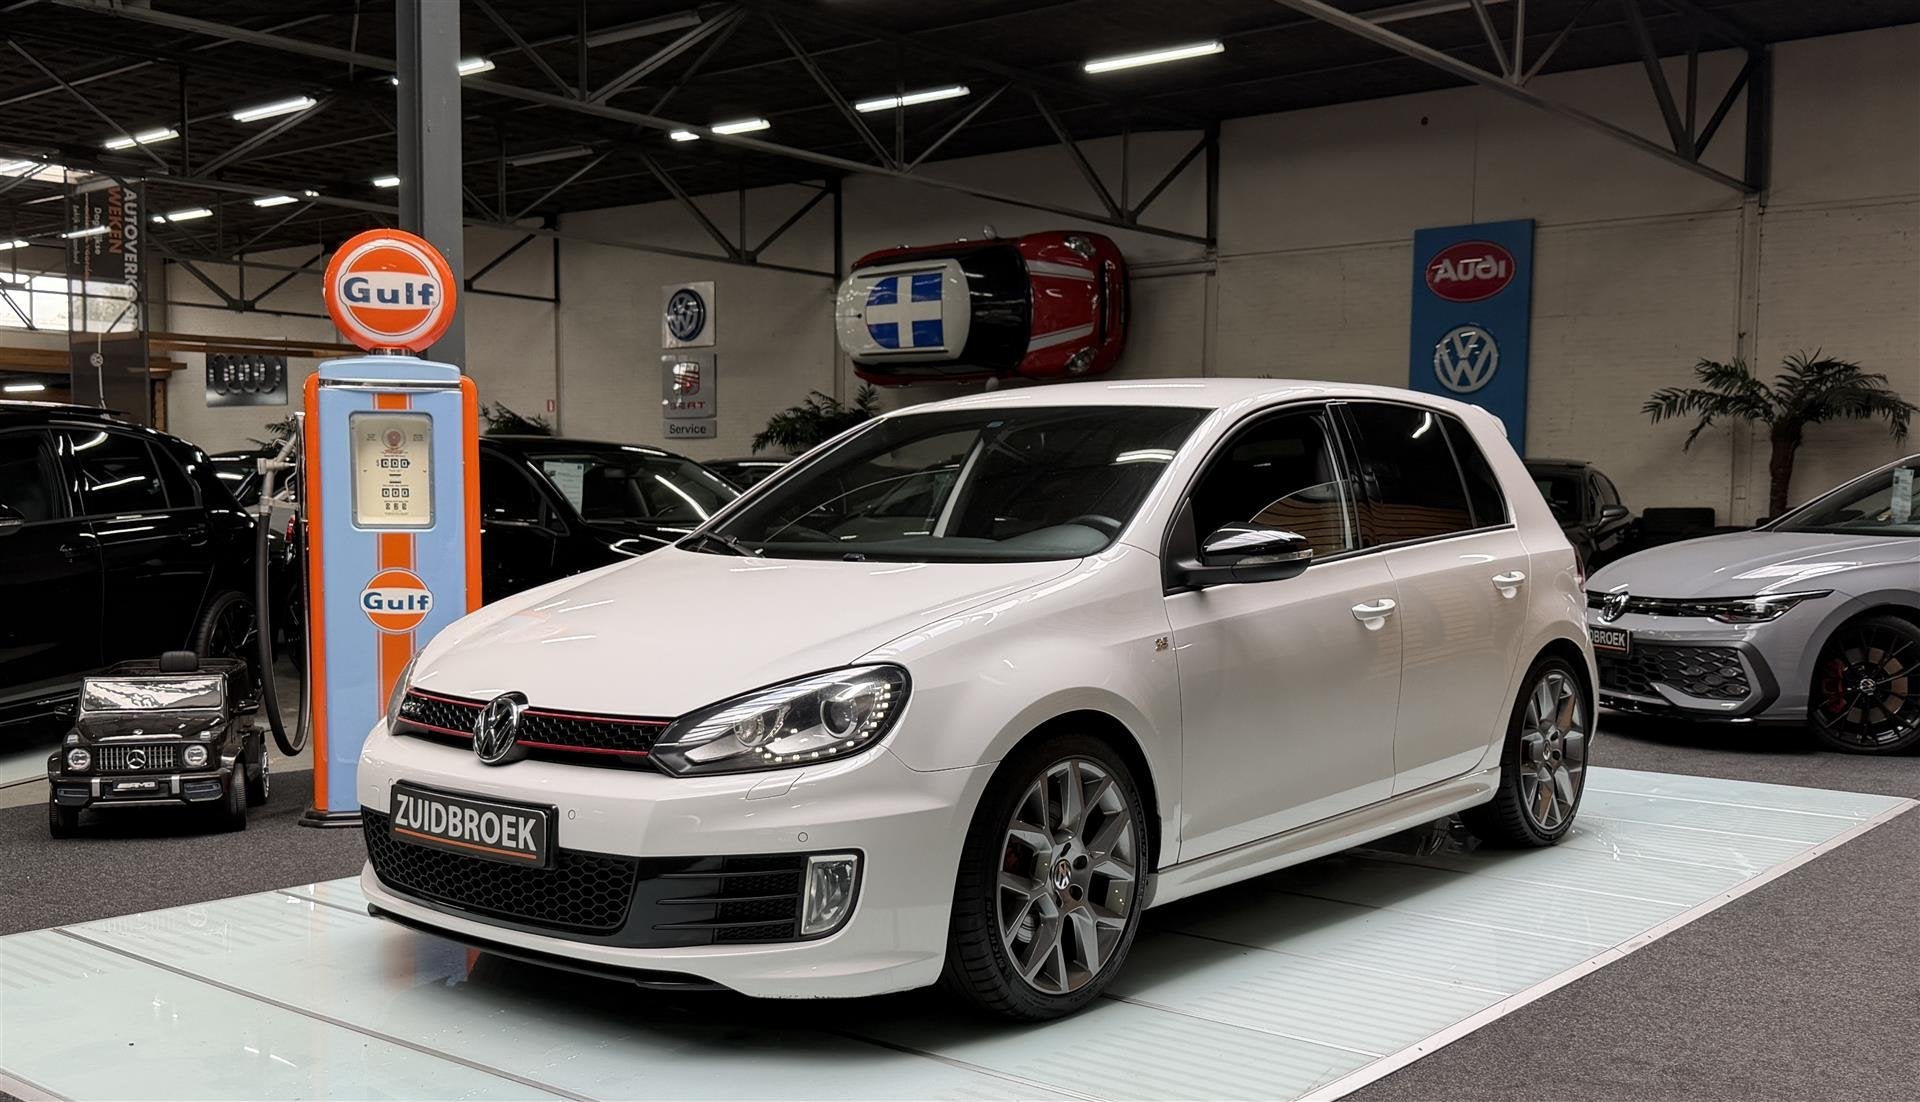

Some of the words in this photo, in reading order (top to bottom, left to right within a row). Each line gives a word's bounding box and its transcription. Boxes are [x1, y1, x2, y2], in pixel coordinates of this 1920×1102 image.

[108, 186, 122, 254] WEKEN
[1433, 255, 1506, 283] Audi
[343, 277, 434, 306] Gulf
[669, 424, 706, 434] Service
[363, 592, 430, 610] Gulf
[395, 794, 537, 851] ZUIDBROEK
